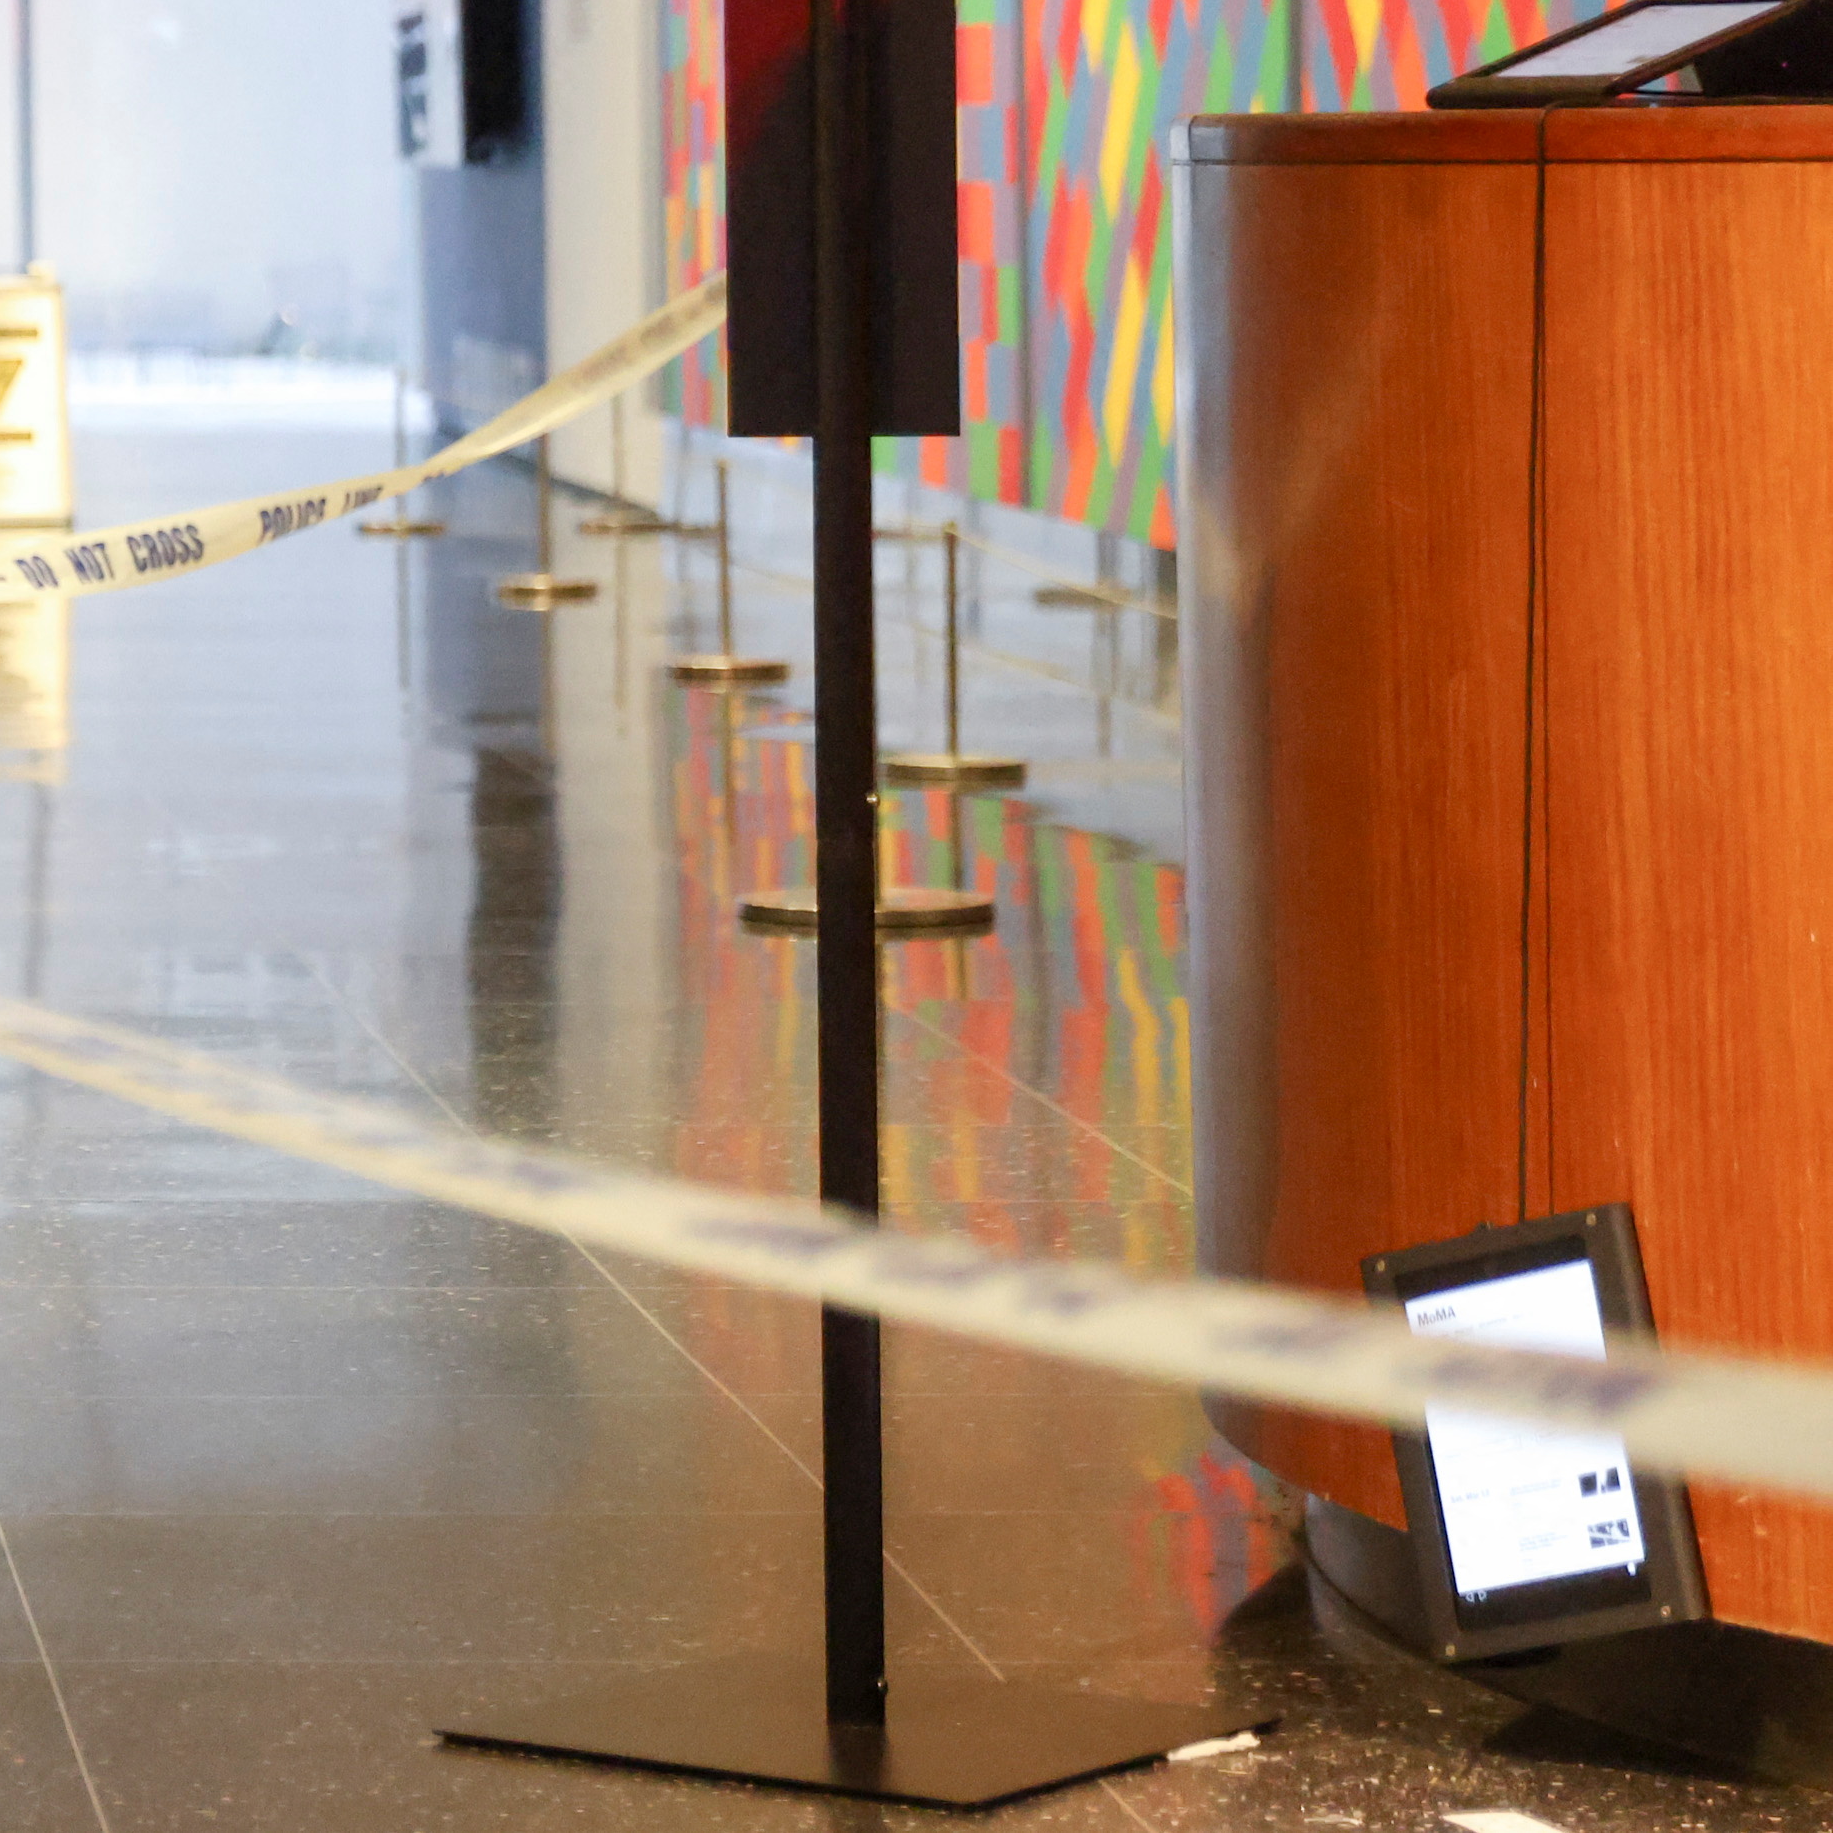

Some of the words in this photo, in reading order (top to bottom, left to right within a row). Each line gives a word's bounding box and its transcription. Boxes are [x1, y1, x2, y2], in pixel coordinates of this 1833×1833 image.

[14, 555, 59, 590] DO
[64, 542, 115, 586] NOT
[125, 524, 204, 575] CROSS
[1417, 1304, 1457, 1328] MoMA
